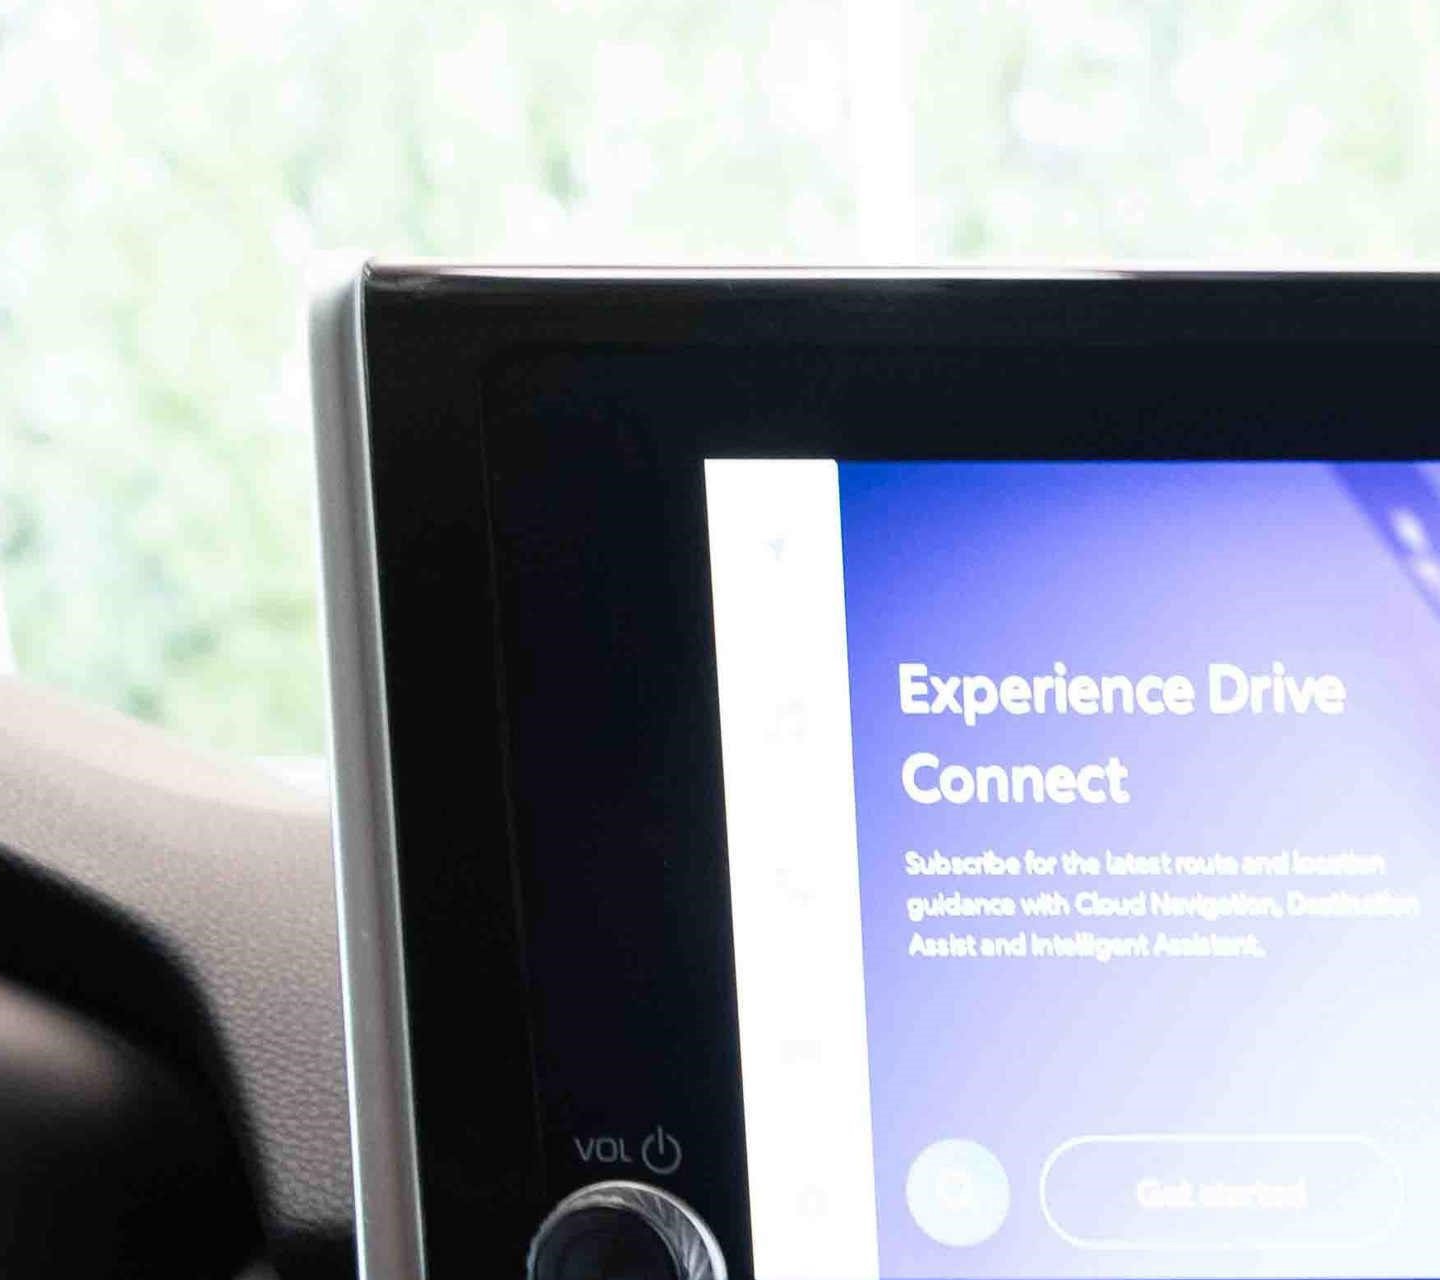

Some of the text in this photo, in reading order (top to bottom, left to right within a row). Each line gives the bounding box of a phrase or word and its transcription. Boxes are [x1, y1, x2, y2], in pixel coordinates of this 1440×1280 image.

[898, 661, 1348, 726] Experience Drive
[901, 752, 1132, 804] Connect
[905, 849, 1020, 876] Subscribe
[1024, 849, 1058, 876] for
[1061, 849, 1100, 876] the
[1106, 849, 1172, 876] latest
[1174, 852, 1239, 876] route
[1241, 849, 1289, 876] and
[907, 891, 1017, 922] guidance
[1020, 891, 1071, 917] with
[1074, 891, 1147, 917] Cloud
[908, 931, 978, 958] Assist
[980, 930, 1027, 958] and
[1030, 930, 1151, 963] Intelligent
[573, 1136, 633, 1164] VOL
